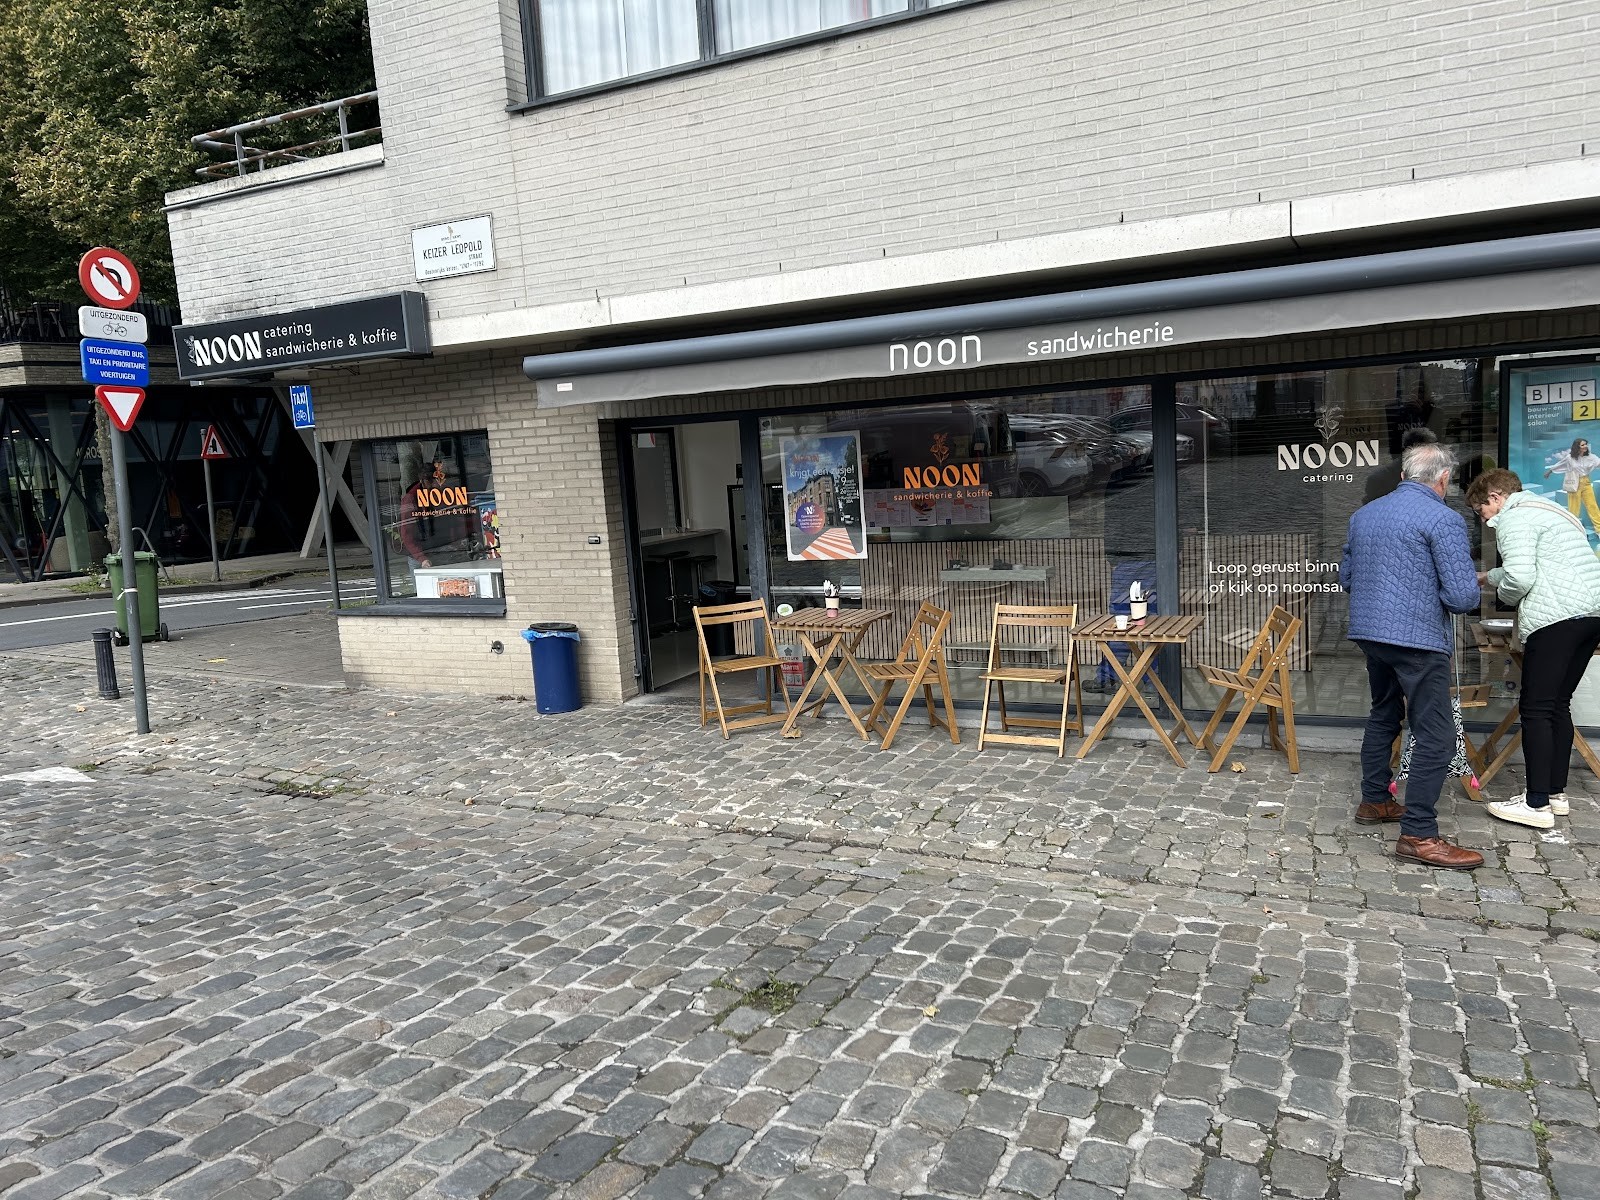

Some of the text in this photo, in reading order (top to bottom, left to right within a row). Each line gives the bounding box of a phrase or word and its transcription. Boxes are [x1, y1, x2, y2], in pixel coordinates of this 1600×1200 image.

[423, 240, 482, 260] KEIZER LEOPOLD
[90, 310, 139, 322] UITGEZONDERD
[263, 322, 312, 339] catering
[1027, 321, 1174, 356] sandwicherie
[194, 331, 262, 367] NOON
[266, 328, 397, 358] sandwicherie & koffie
[87, 346, 145, 359] UITGEZONDERD BUS,
[889, 335, 982, 372] noon
[89, 358, 146, 370] TAXI EN PRIORITAIRE
[100, 371, 136, 381] VOERTUIGEN
[293, 392, 307, 405] TAXI
[1527, 412, 1560, 420] interieur
[1579, 405, 1589, 417] 2
[1277, 440, 1379, 471] NOON
[789, 468, 810, 479] krijgt
[812, 468, 829, 476] een
[903, 463, 981, 490] NOON
[1302, 473, 1353, 483] catering
[416, 486, 468, 508] NOON
[893, 488, 993, 501] sandwicherie & koffie
[1209, 559, 1340, 577] Loop gerust binn
[1209, 580, 1225, 593] of
[1228, 580, 1253, 597] kijk
[1257, 583, 1278, 597] op
